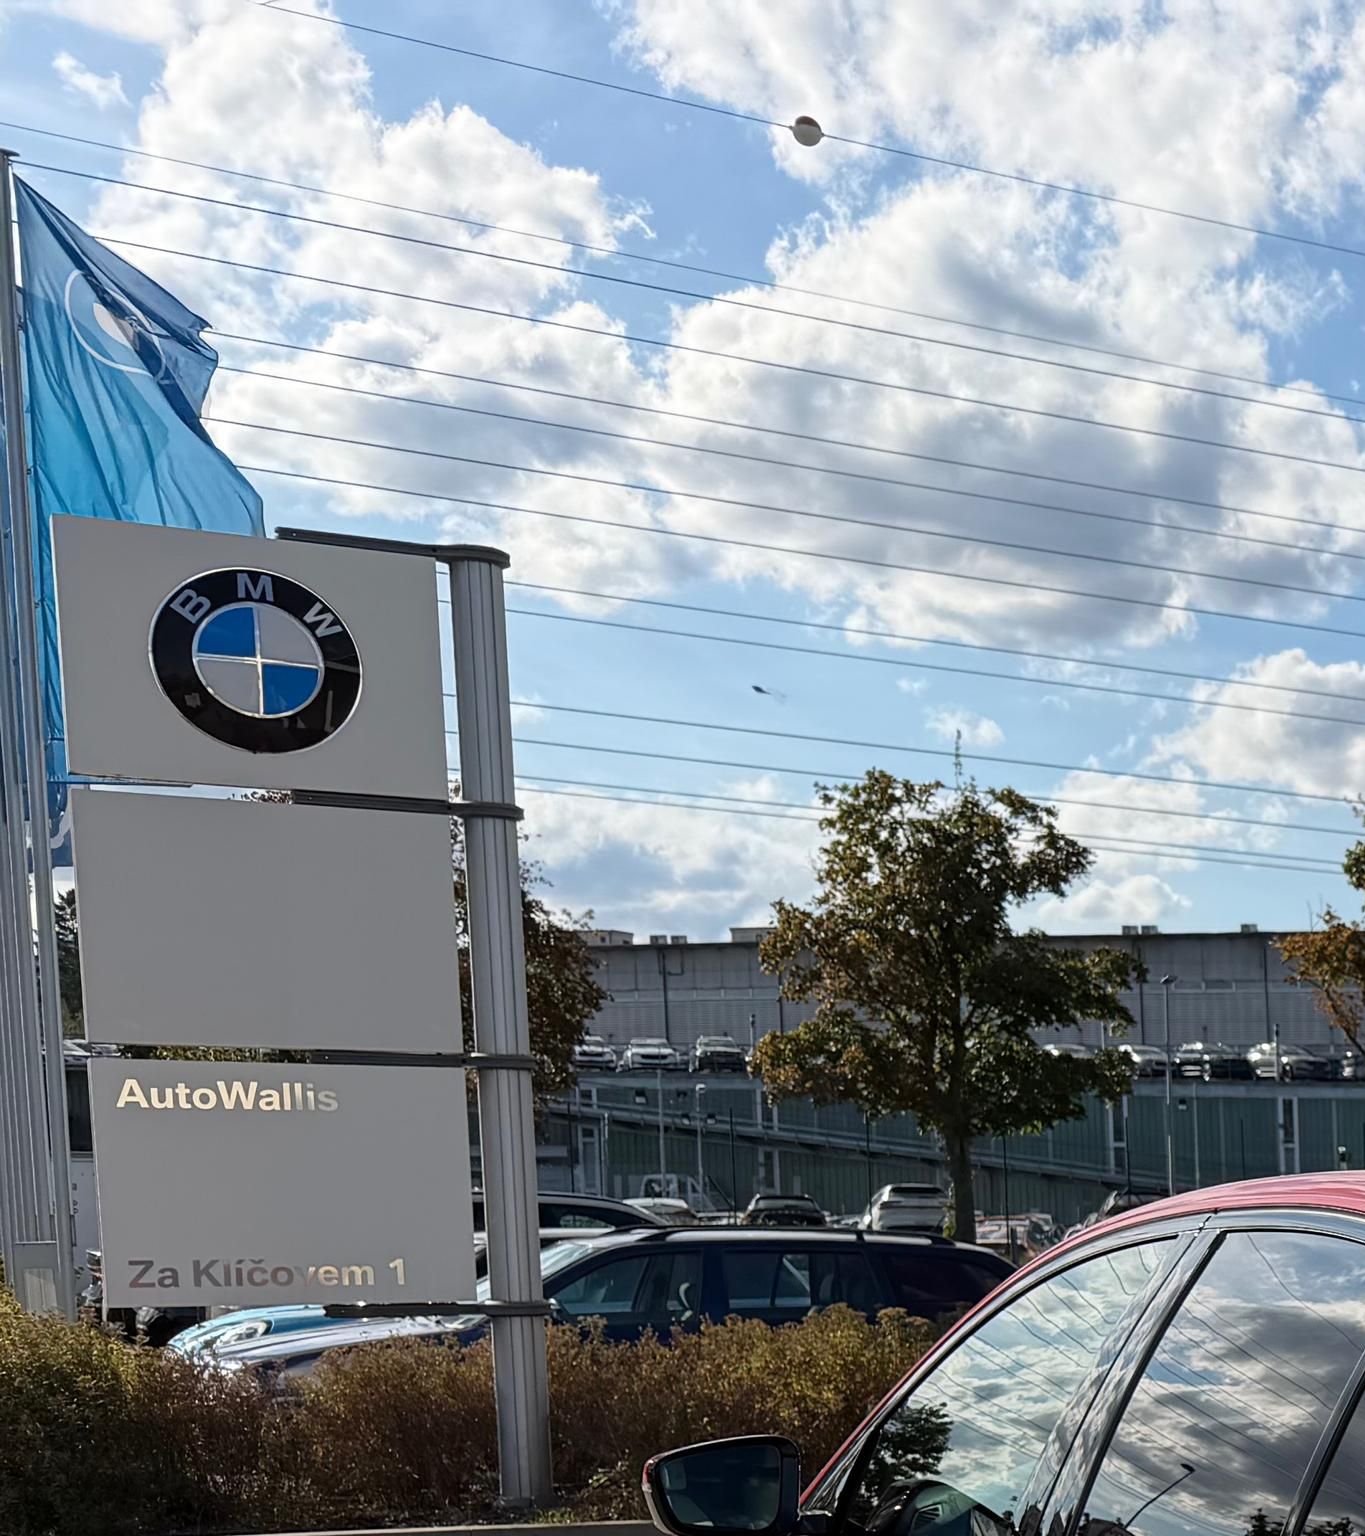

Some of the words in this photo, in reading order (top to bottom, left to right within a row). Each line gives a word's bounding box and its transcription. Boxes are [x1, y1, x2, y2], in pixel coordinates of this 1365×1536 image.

[169, 573, 343, 625] BMW
[116, 1078, 338, 1111] AutoWallis
[128, 1260, 180, 1288] Za
[192, 1258, 374, 1288] Klíčovem
[388, 1258, 406, 1286] 1
